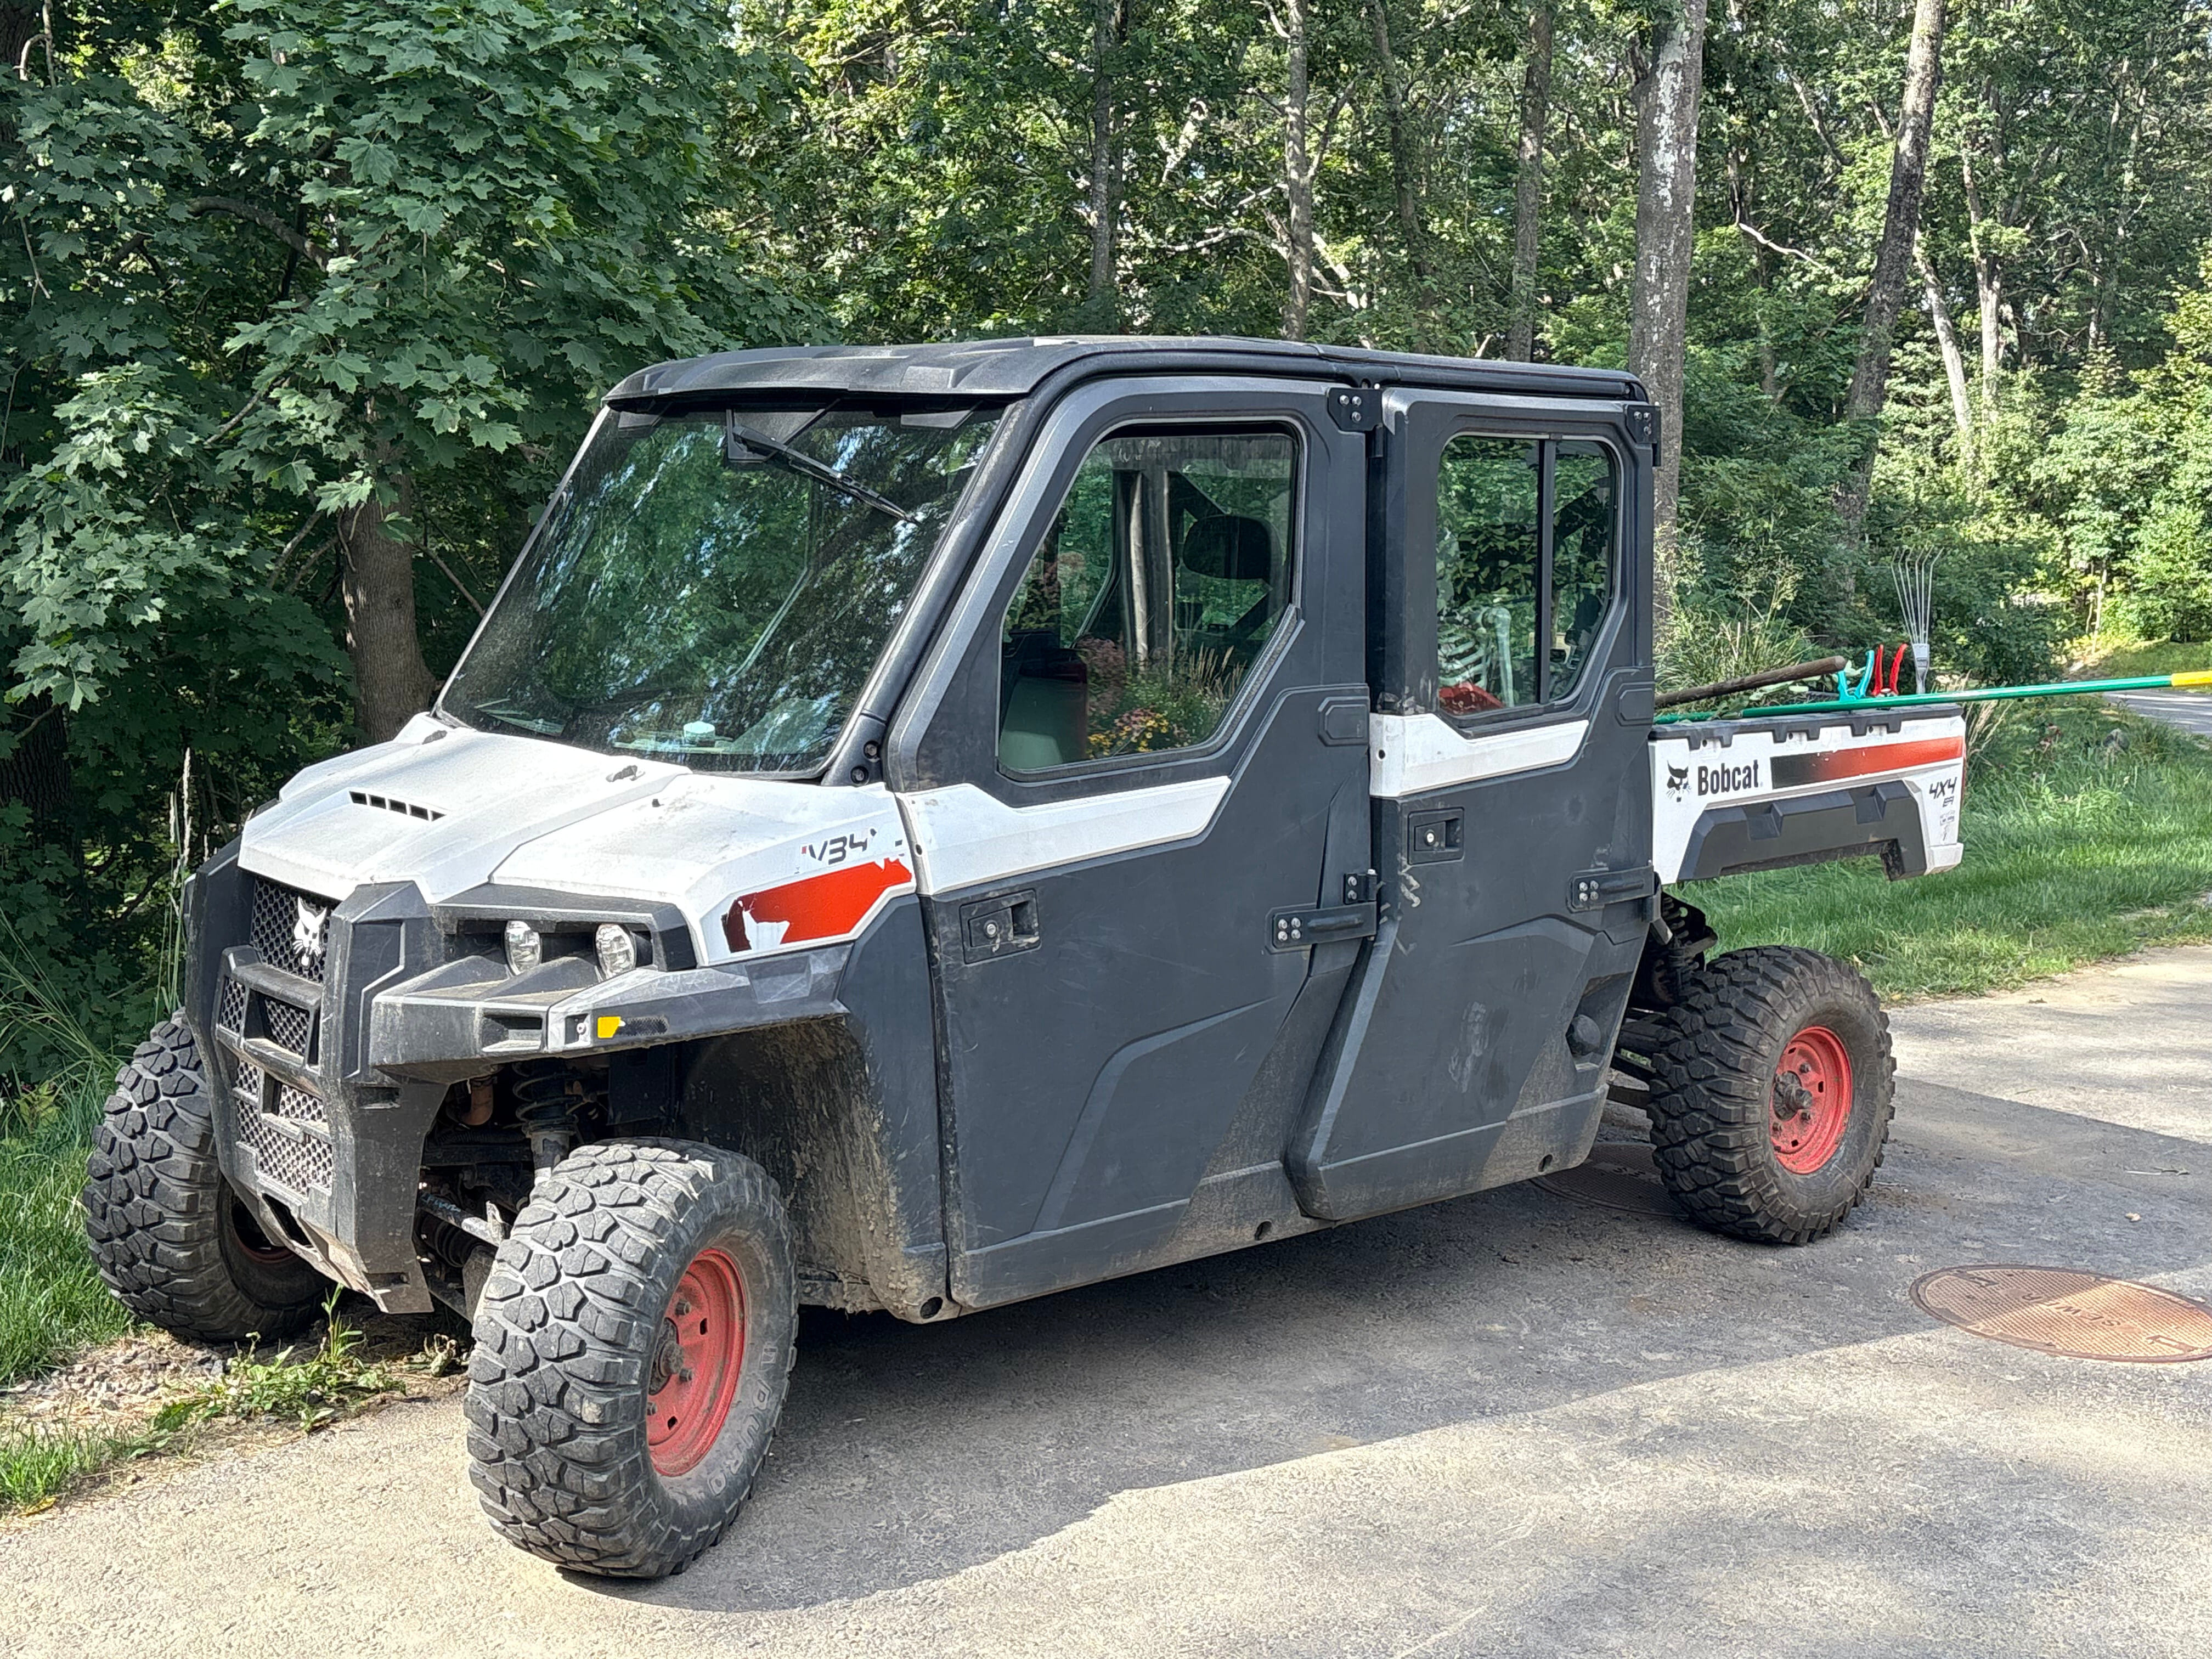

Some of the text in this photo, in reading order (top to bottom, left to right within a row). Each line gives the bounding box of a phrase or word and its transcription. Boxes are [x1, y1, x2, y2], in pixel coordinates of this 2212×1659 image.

[1697, 759, 1759, 796] Bobcat
[1929, 776, 1957, 799] 4X4
[802, 832, 868, 865] V34
[2021, 1293, 2121, 1327] SEWER
